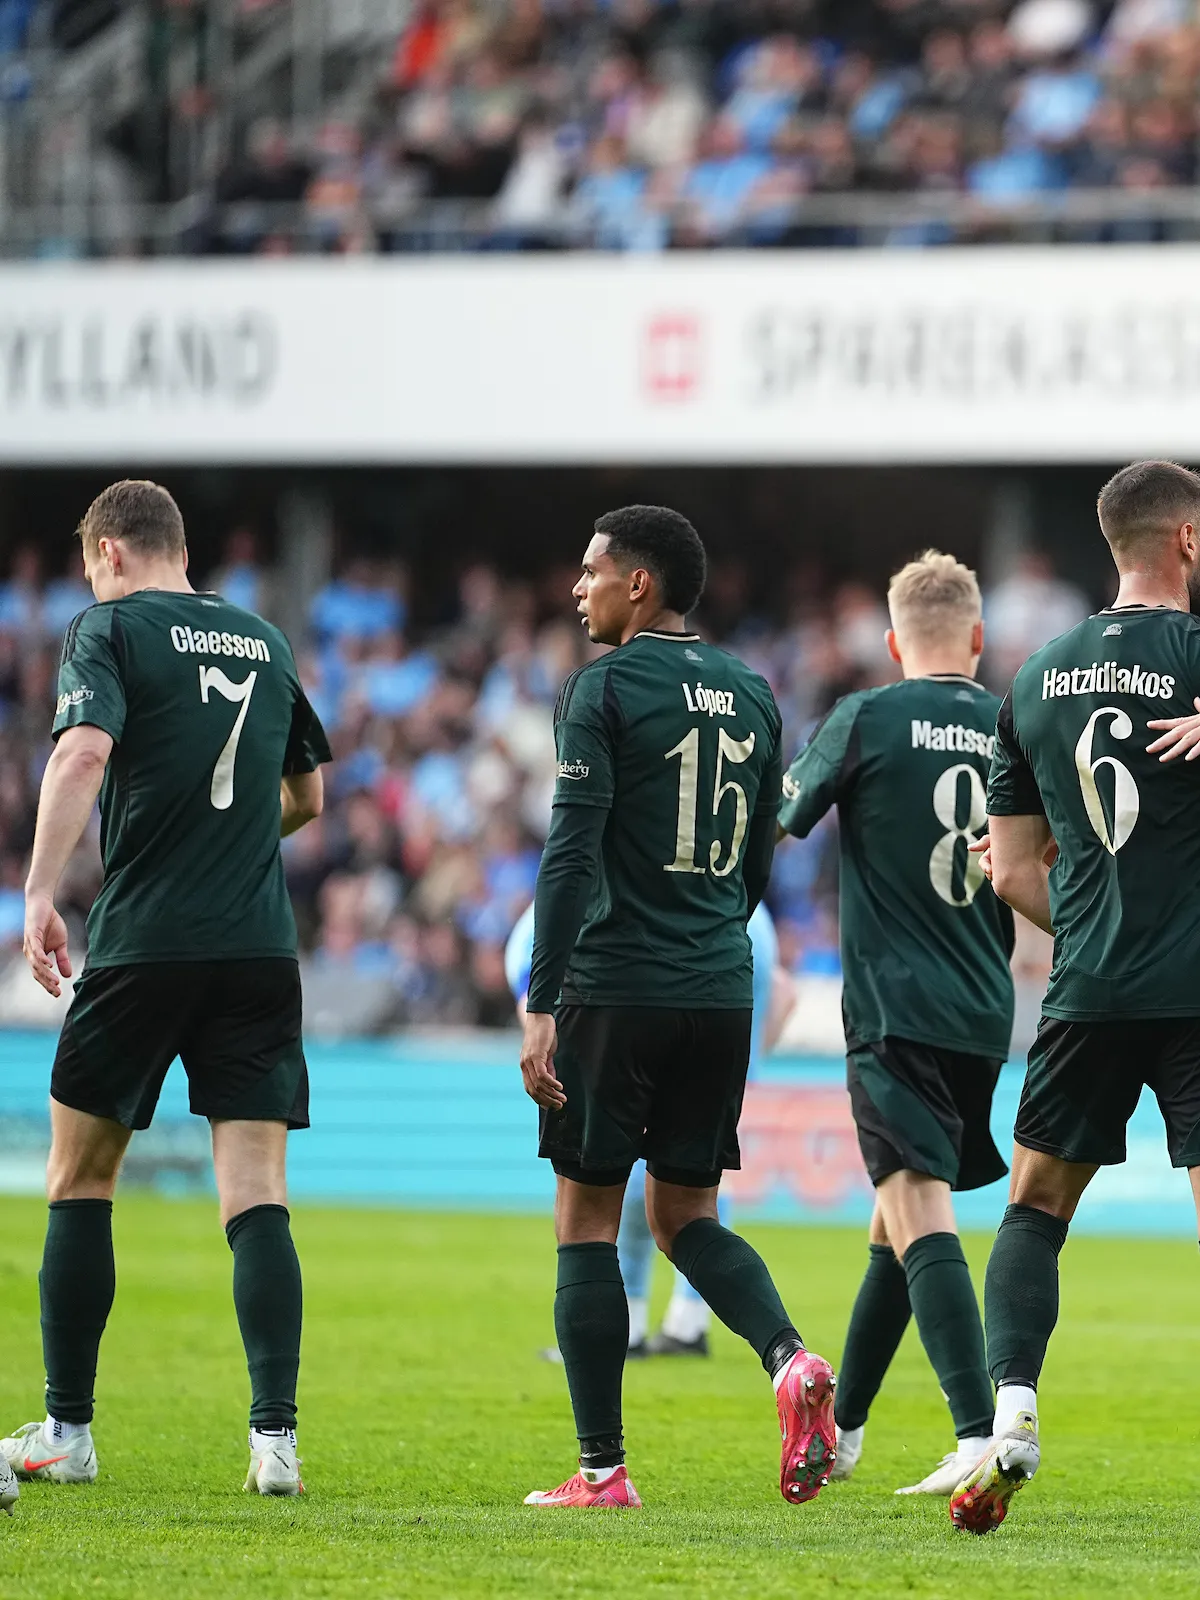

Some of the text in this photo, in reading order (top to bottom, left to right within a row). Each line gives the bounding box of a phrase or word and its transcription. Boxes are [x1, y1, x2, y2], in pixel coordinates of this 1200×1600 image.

[170, 625, 271, 663] Claesson
[682, 682, 737, 717] López
[1042, 661, 1176, 700] Hatzidiakos
[199, 665, 258, 811] 7
[663, 727, 756, 877] 15
[1075, 707, 1140, 857] 6
[929, 763, 989, 908] 8
